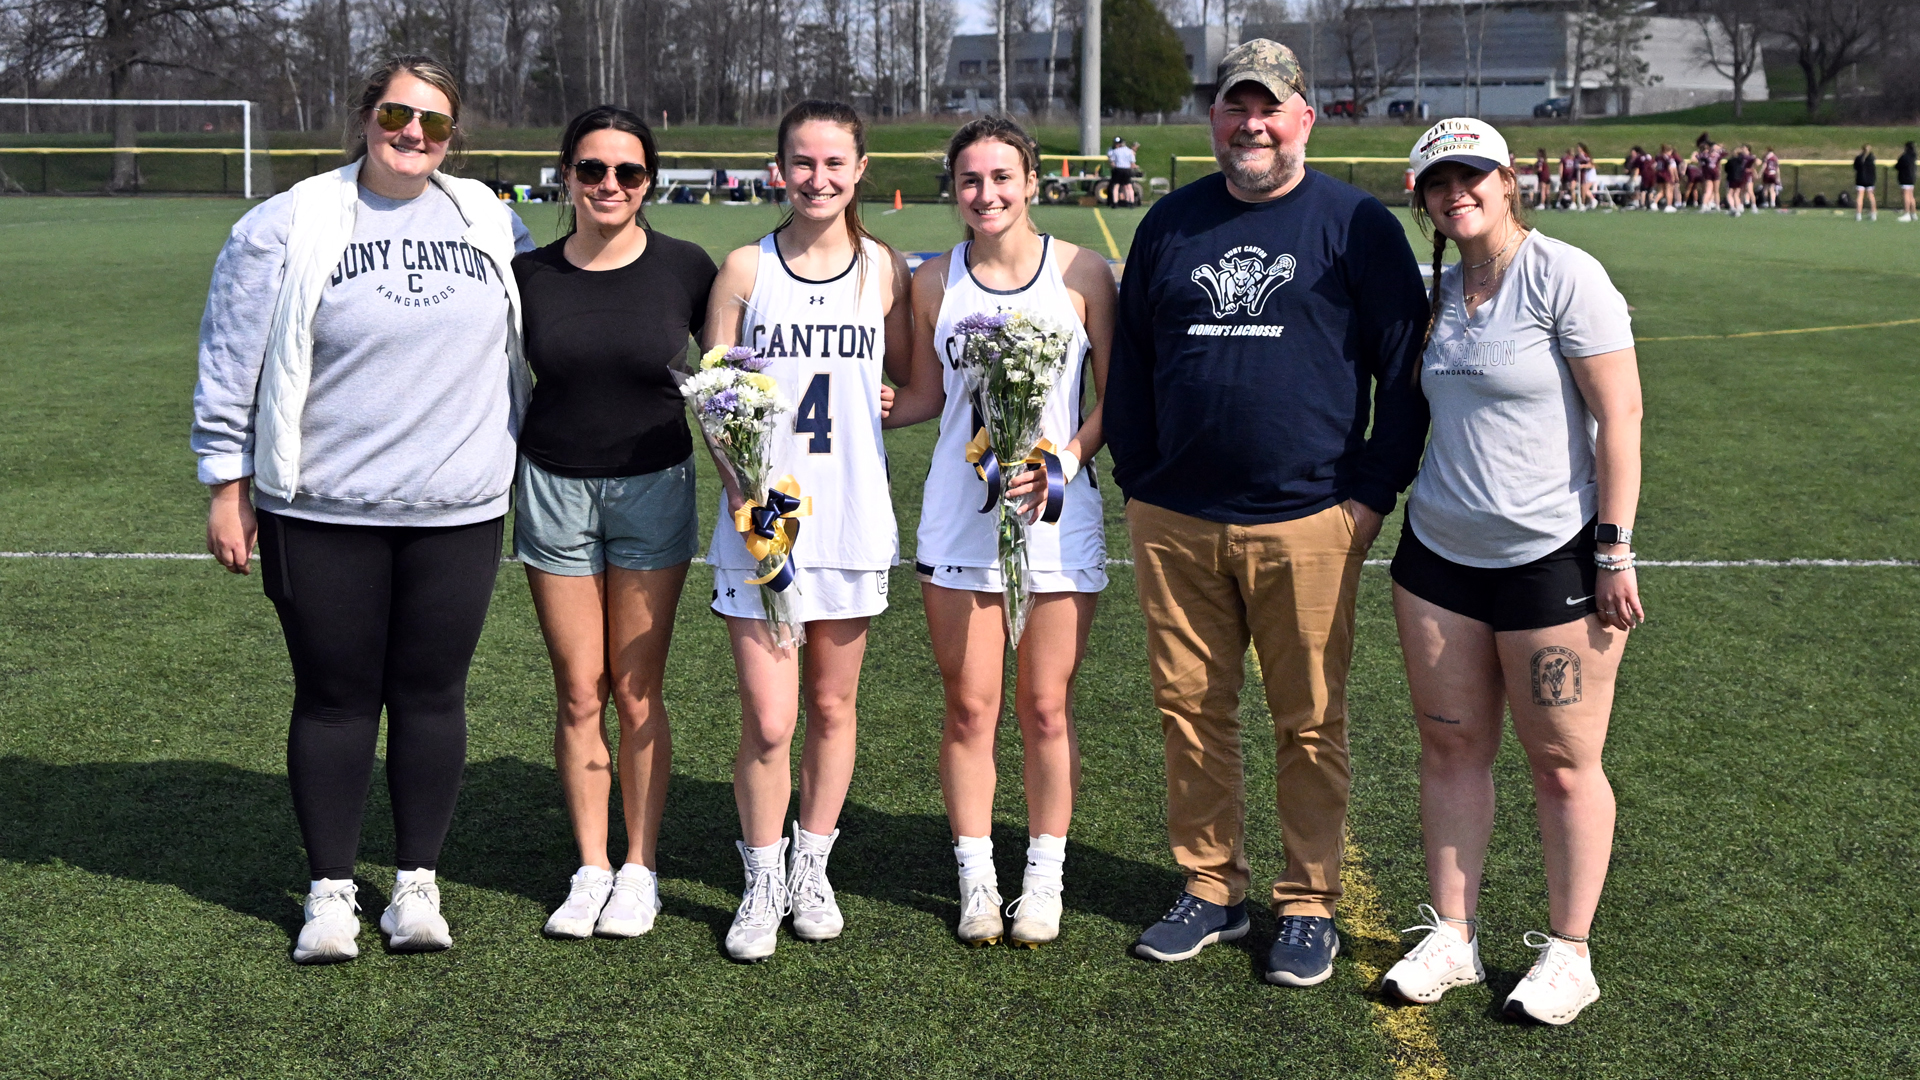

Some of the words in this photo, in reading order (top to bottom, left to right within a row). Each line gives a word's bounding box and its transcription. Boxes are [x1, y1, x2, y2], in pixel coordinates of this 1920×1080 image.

[1426, 144, 1474, 160] LACROSSE
[402, 238, 488, 285] CANTON
[1224, 246, 1242, 259] SUNY
[1243, 245, 1268, 259] CANTON
[408, 273, 423, 293] C
[376, 284, 456, 308] KANGAROOS
[753, 324, 876, 360] CANTON
[1187, 324, 1232, 336] WOMEN'S
[1230, 325, 1285, 337] LACROSSE
[1452, 340, 1515, 367] CANTON
[793, 372, 833, 455] 4
